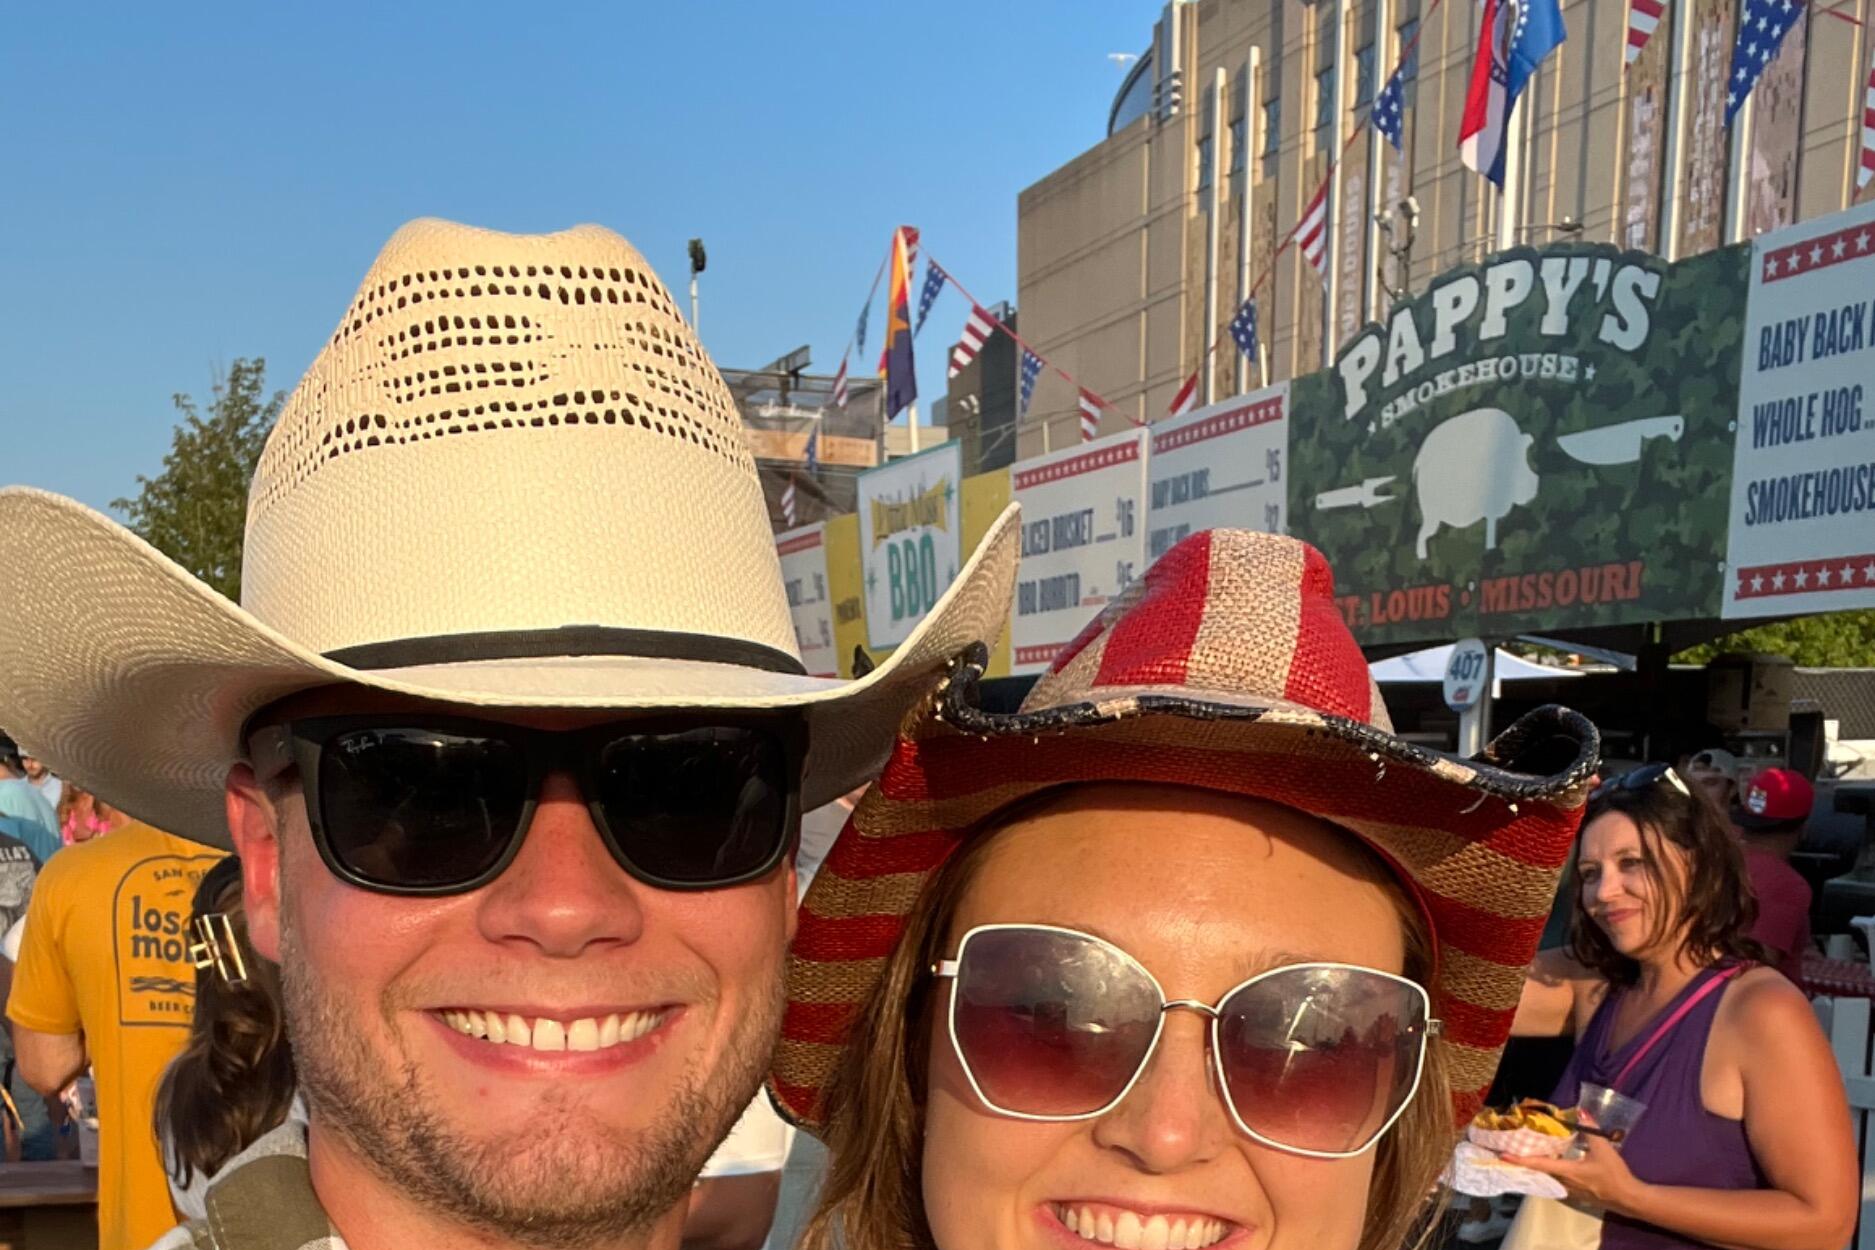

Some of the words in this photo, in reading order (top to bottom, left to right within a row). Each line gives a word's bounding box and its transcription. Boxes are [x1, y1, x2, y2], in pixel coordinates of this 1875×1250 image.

[1339, 257, 1660, 420] PAPPY'S
[1758, 315, 1811, 372] BABY
[1812, 302, 1867, 360] BACK
[1381, 353, 1579, 427] SMOKEHOUSE
[1753, 393, 1818, 449] WHOLE
[1821, 384, 1863, 438] HOG
[1746, 463, 1875, 526] SMOKEHOUSE
[1371, 585, 1451, 625] LOUIS
[1480, 561, 1644, 613] MISSOURI
[1450, 653, 1485, 680] 407
[153, 869, 183, 881] SAN
[132, 895, 181, 935] los
[149, 1000, 181, 1013] BEER
